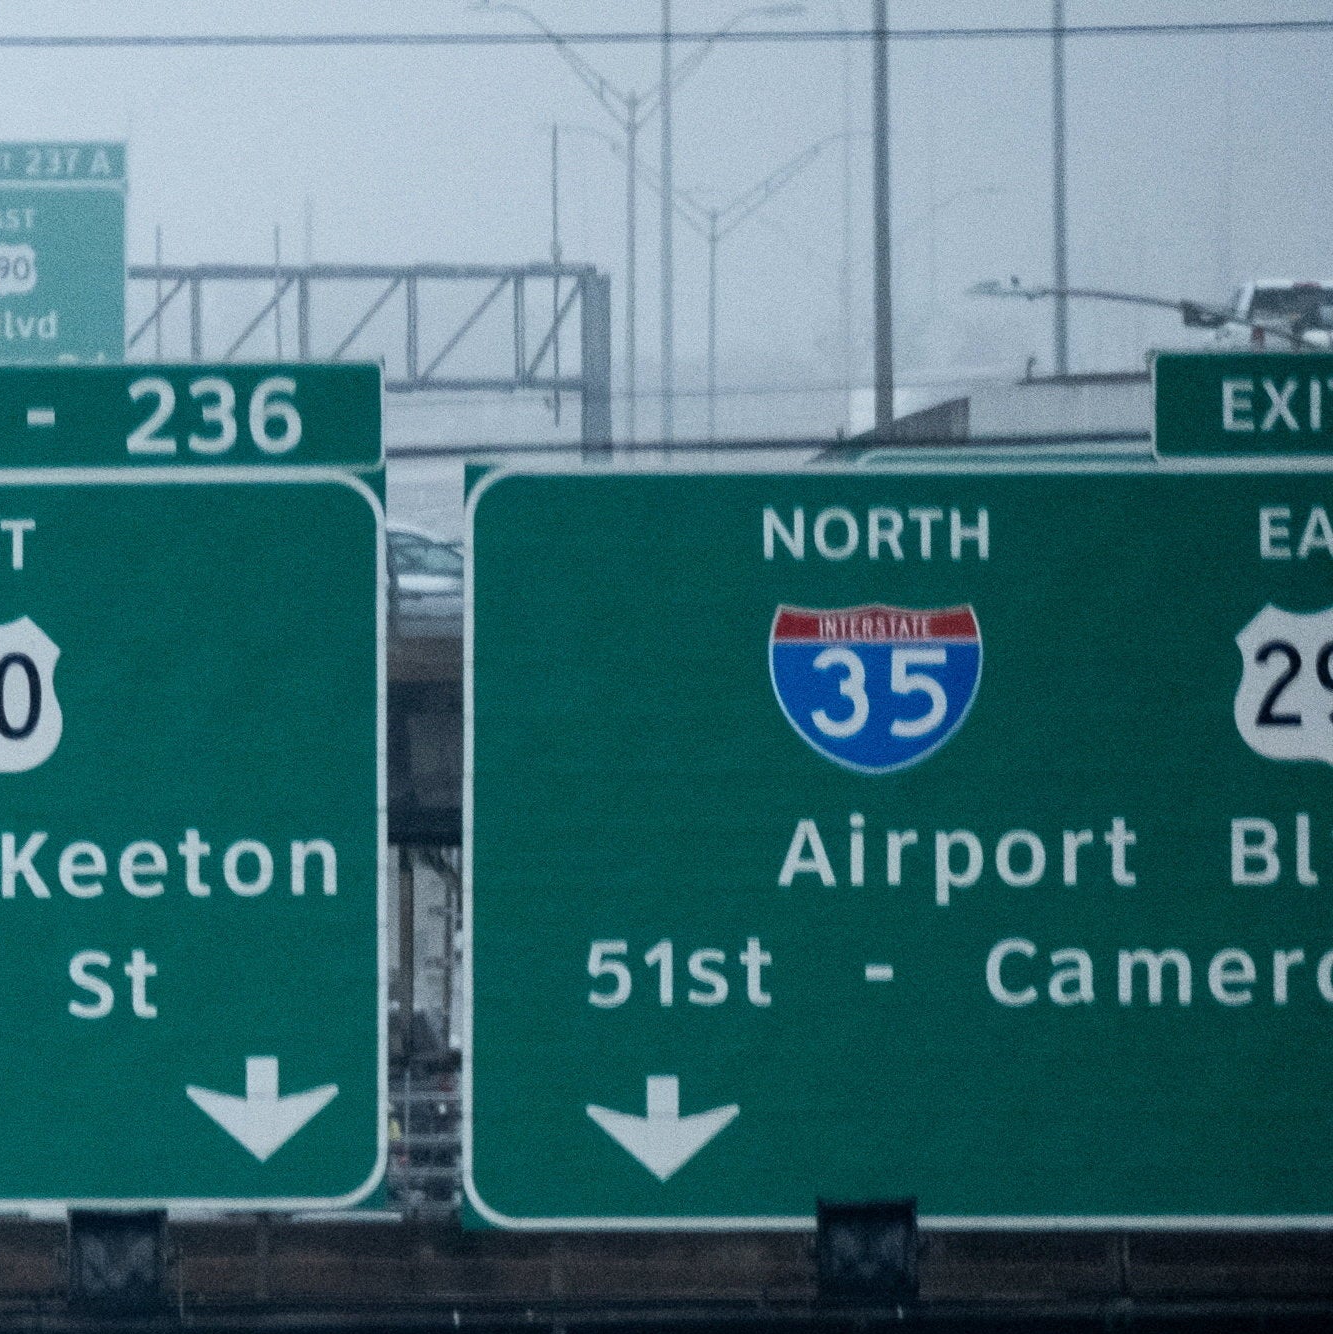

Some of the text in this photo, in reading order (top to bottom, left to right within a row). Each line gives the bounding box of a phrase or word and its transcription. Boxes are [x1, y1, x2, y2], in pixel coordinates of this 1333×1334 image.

[26, 148, 79, 175] 237
[91, 149, 110, 174] A
[127, 378, 301, 453] 236
[1223, 381, 1333, 431] EXI
[763, 509, 988, 558] NORTH
[819, 617, 930, 641] INTERSTATE
[812, 646, 946, 737] 35
[2, 830, 336, 897] Keeton
[779, 814, 1135, 905] Airport
[70, 951, 156, 1018] St
[588, 939, 771, 1006] 51st
